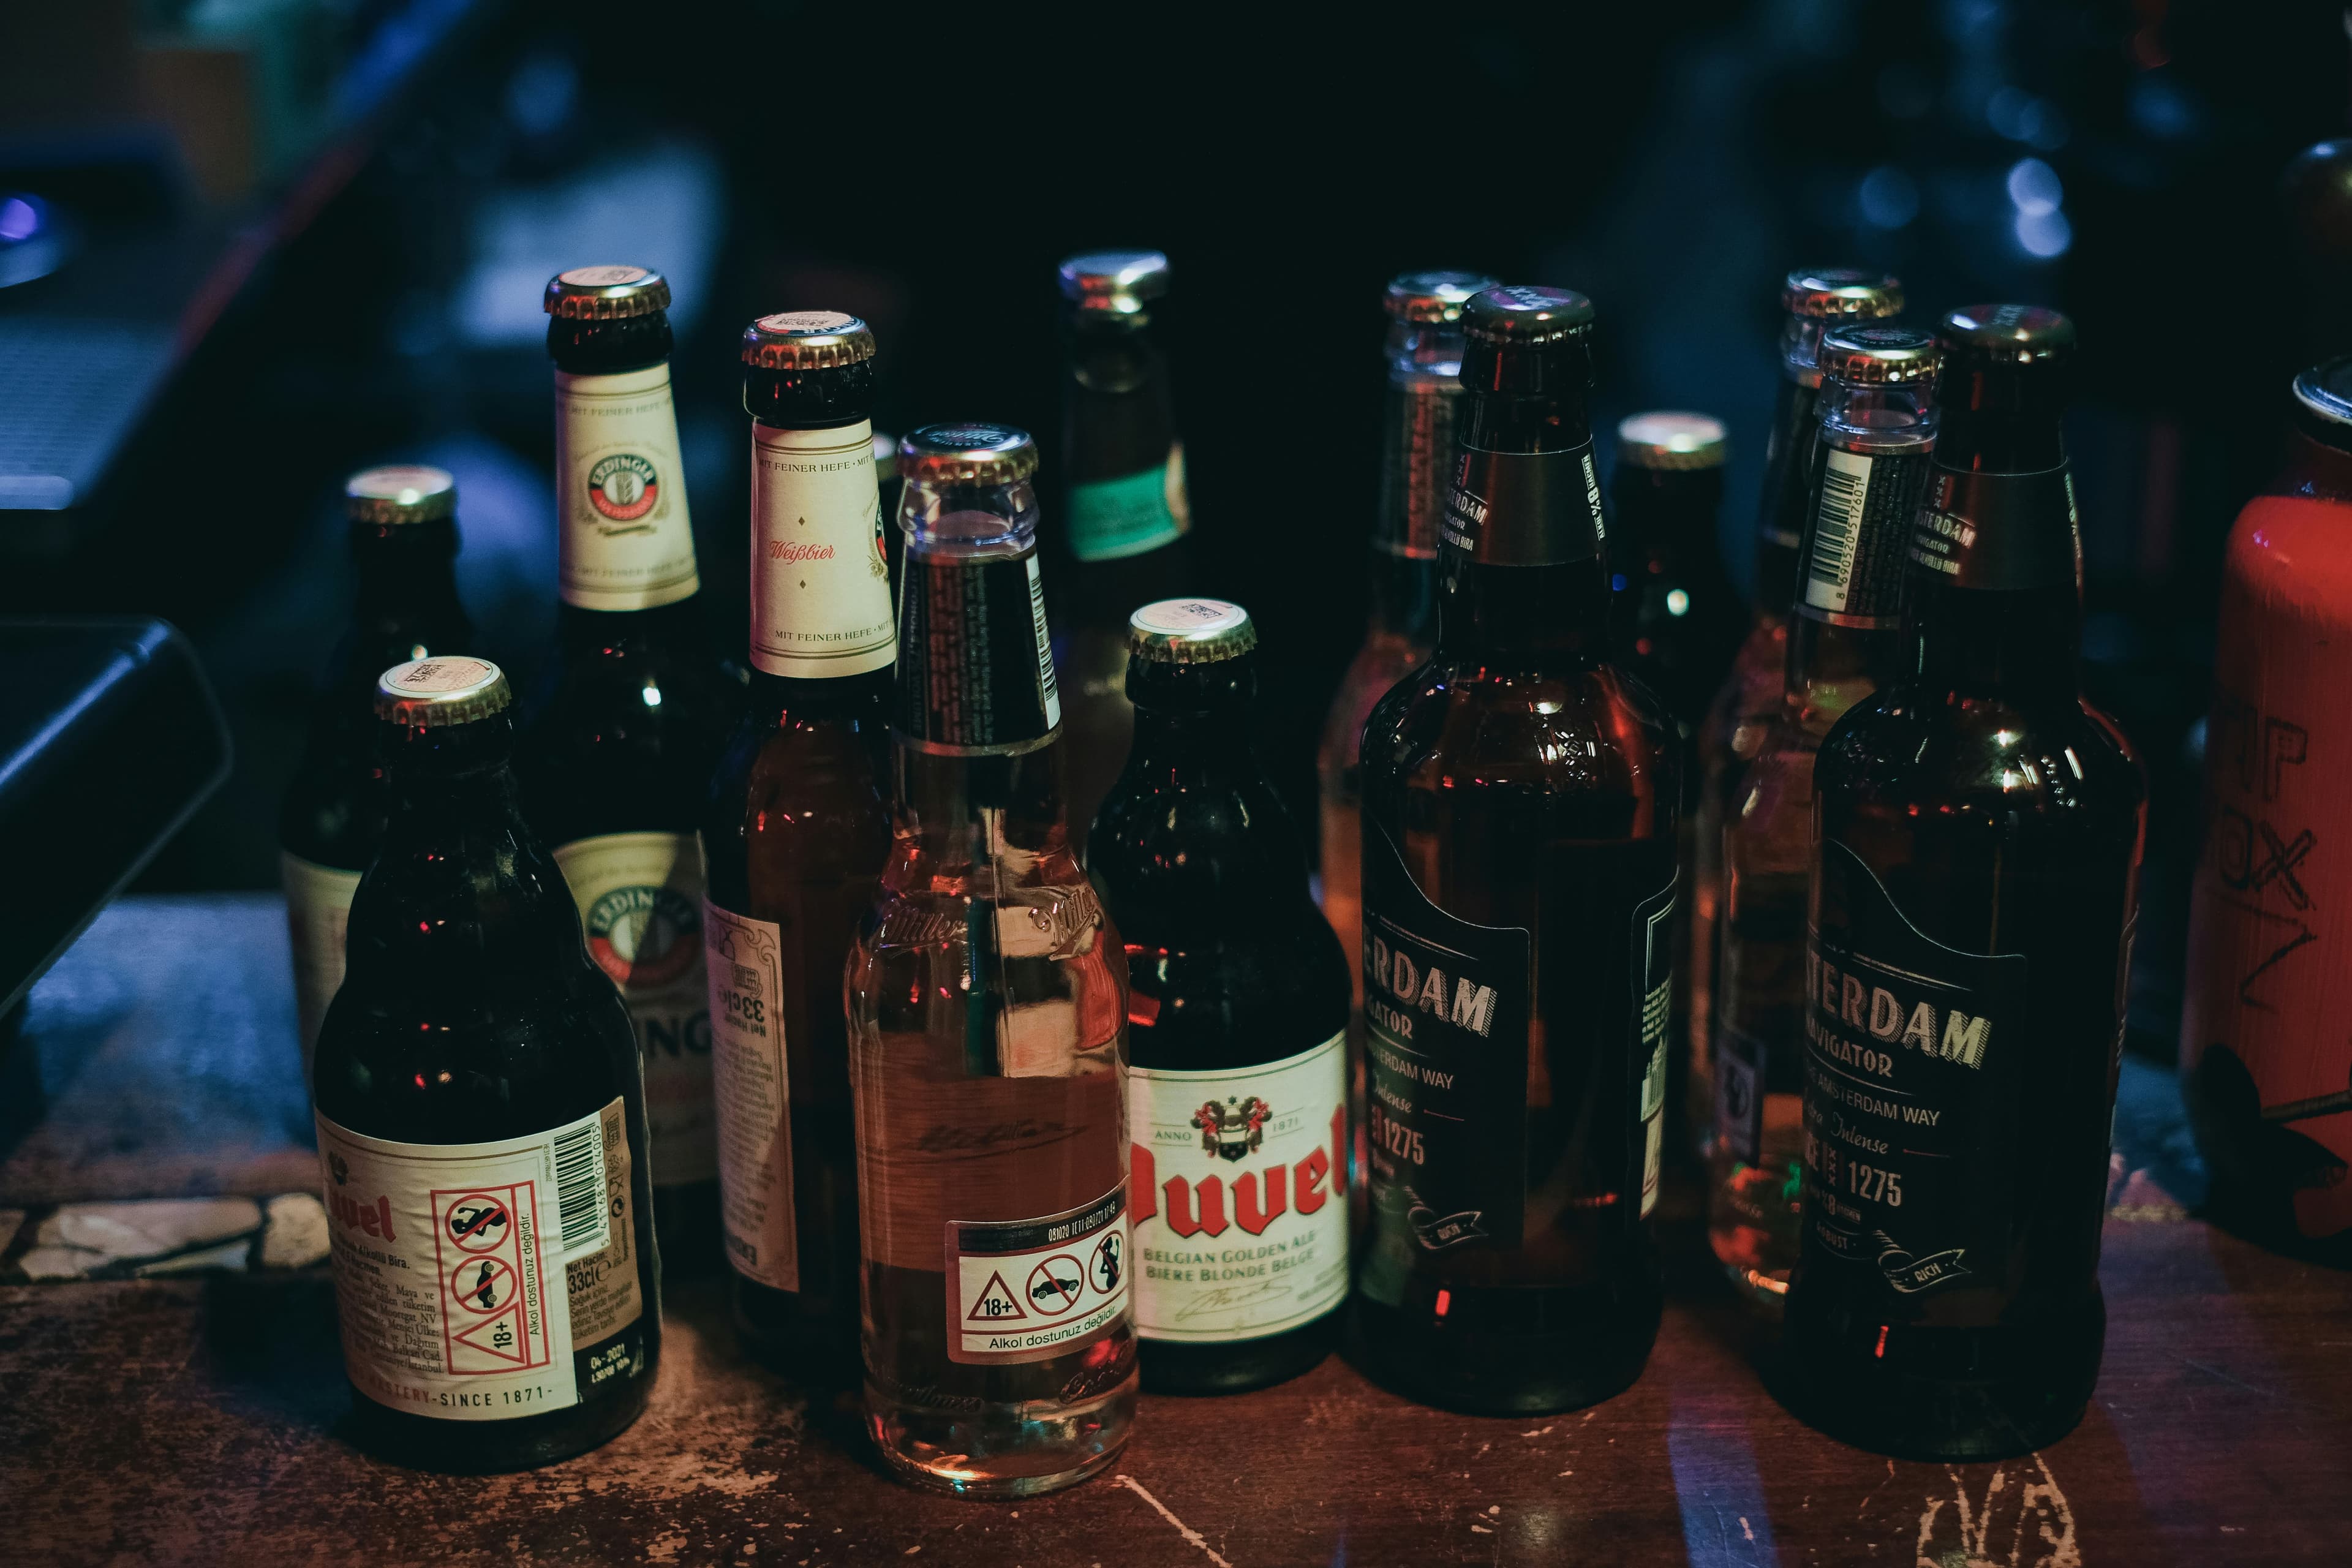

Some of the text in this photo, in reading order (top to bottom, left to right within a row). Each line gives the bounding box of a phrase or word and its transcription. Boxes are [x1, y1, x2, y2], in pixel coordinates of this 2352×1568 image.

[774, 461, 817, 473] FEINER
[821, 461, 851, 472] HEFE
[769, 540, 836, 565] Weißbier
[775, 627, 872, 643] MIT FEINER HEFE
[1422, 1068, 1454, 1090] WAY
[1817, 1072, 1898, 1121] AMSTERDAM
[1902, 1106, 1941, 1127] WAY
[1155, 1131, 1192, 1142] ANNO
[1383, 1117, 1425, 1166] 1275
[1830, 1111, 1890, 1155] Intense
[1848, 1160, 1902, 1207] 1275
[388, 1254, 410, 1270] Bira.
[567, 1251, 608, 1275] Net Hacim:
[1143, 1248, 1216, 1264] BELGIAN
[1222, 1242, 1287, 1264] GOLDEN
[1200, 1264, 1265, 1281] BLONDE
[1272, 1248, 1314, 1272] BELGE
[519, 1212, 540, 1336] Alkol dostunuz değildir.
[568, 1266, 595, 1295] 33cl
[1915, 1262, 1942, 1283] RICH
[396, 1284, 418, 1298] Maya
[424, 1291, 435, 1300] ve
[421, 1313, 437, 1324] NV
[984, 1298, 1013, 1317] 18+
[493, 1321, 513, 1349] 18+
[989, 1305, 1117, 1349] Alkol dostunuz değildir.
[422, 1349, 443, 1362] Cad.
